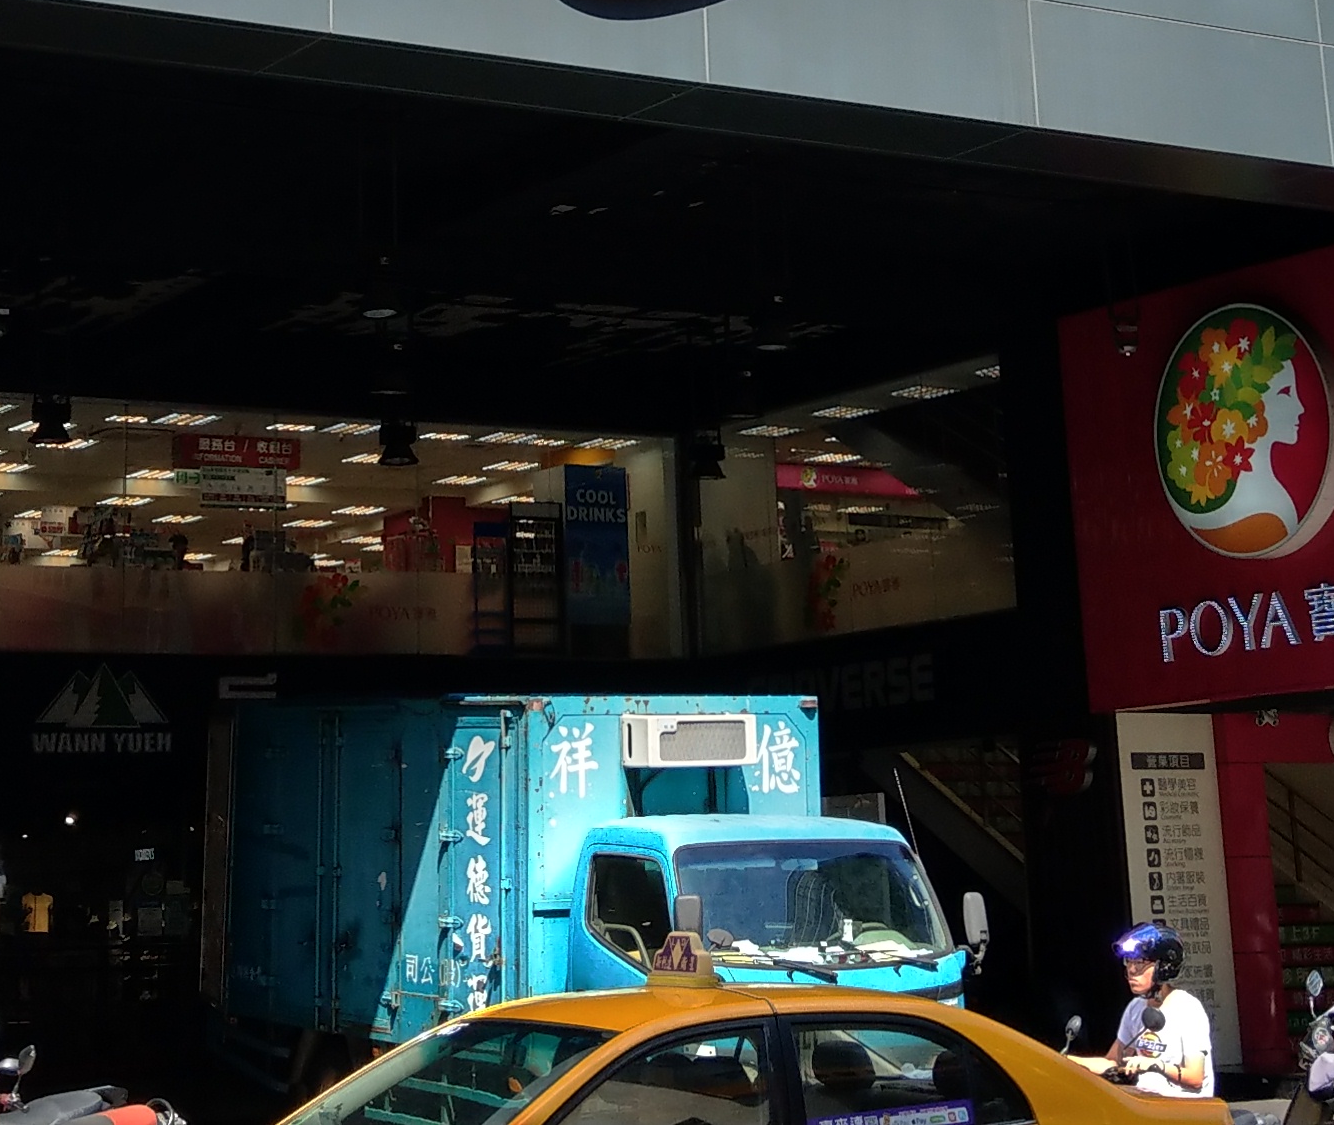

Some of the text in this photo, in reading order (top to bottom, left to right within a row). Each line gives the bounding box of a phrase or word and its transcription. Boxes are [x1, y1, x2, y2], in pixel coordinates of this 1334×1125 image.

[576, 488, 617, 506] COOL
[567, 505, 627, 524] DRINKS
[1159, 591, 1301, 663] POYA
[31, 733, 106, 754] WANN
[549, 721, 801, 798] 祥 億
